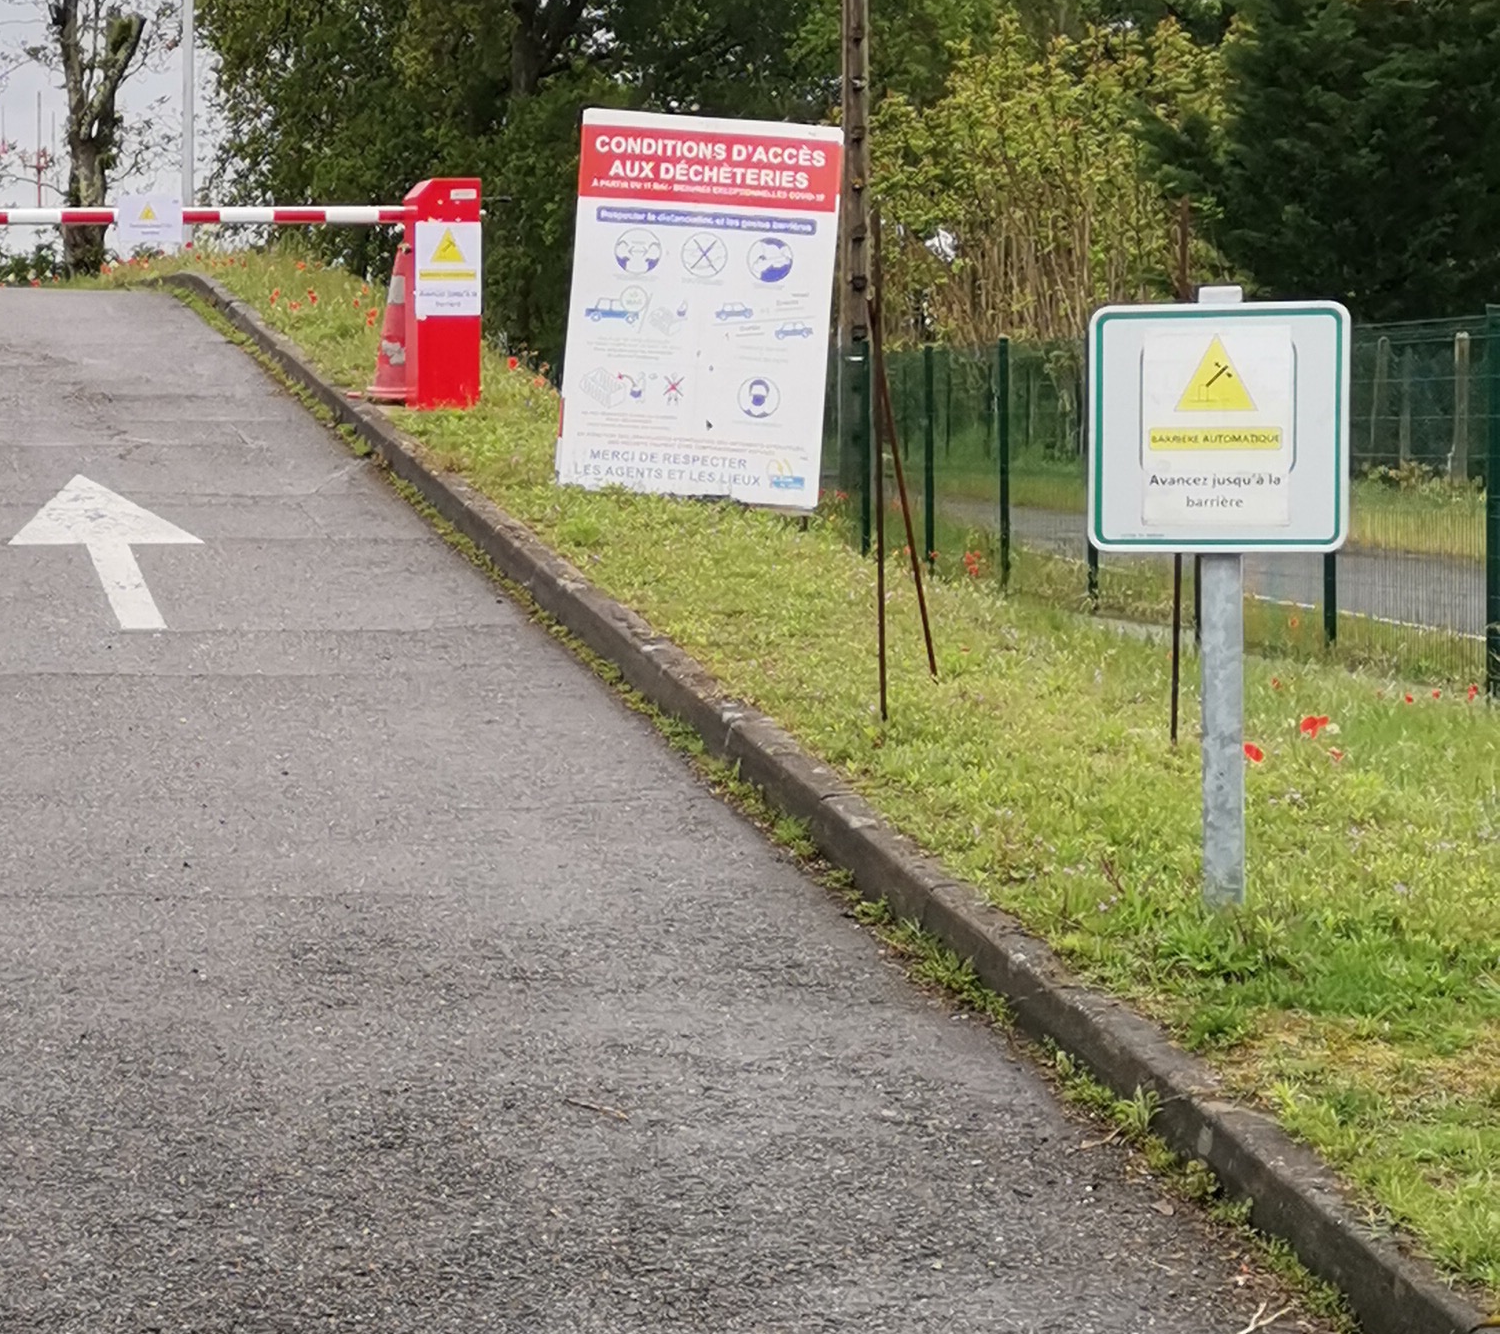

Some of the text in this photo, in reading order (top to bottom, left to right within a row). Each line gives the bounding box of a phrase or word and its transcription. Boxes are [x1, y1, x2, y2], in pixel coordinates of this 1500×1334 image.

[595, 135, 826, 167] CONDITIONS D'ACCÈS
[609, 158, 809, 189] AUX DÉCHÈTERIES
[1202, 434, 1280, 444] AUTOMATIQUE
[589, 448, 748, 470] MERCI DE RESPECTER
[574, 463, 601, 476] LES
[605, 465, 663, 479] AGENTS
[667, 468, 685, 480] ET
[689, 469, 716, 483] LES
[719, 471, 761, 487] LIEUX
[1149, 473, 1282, 489] Avancez jusqu'à la
[1186, 495, 1244, 508] barrière
